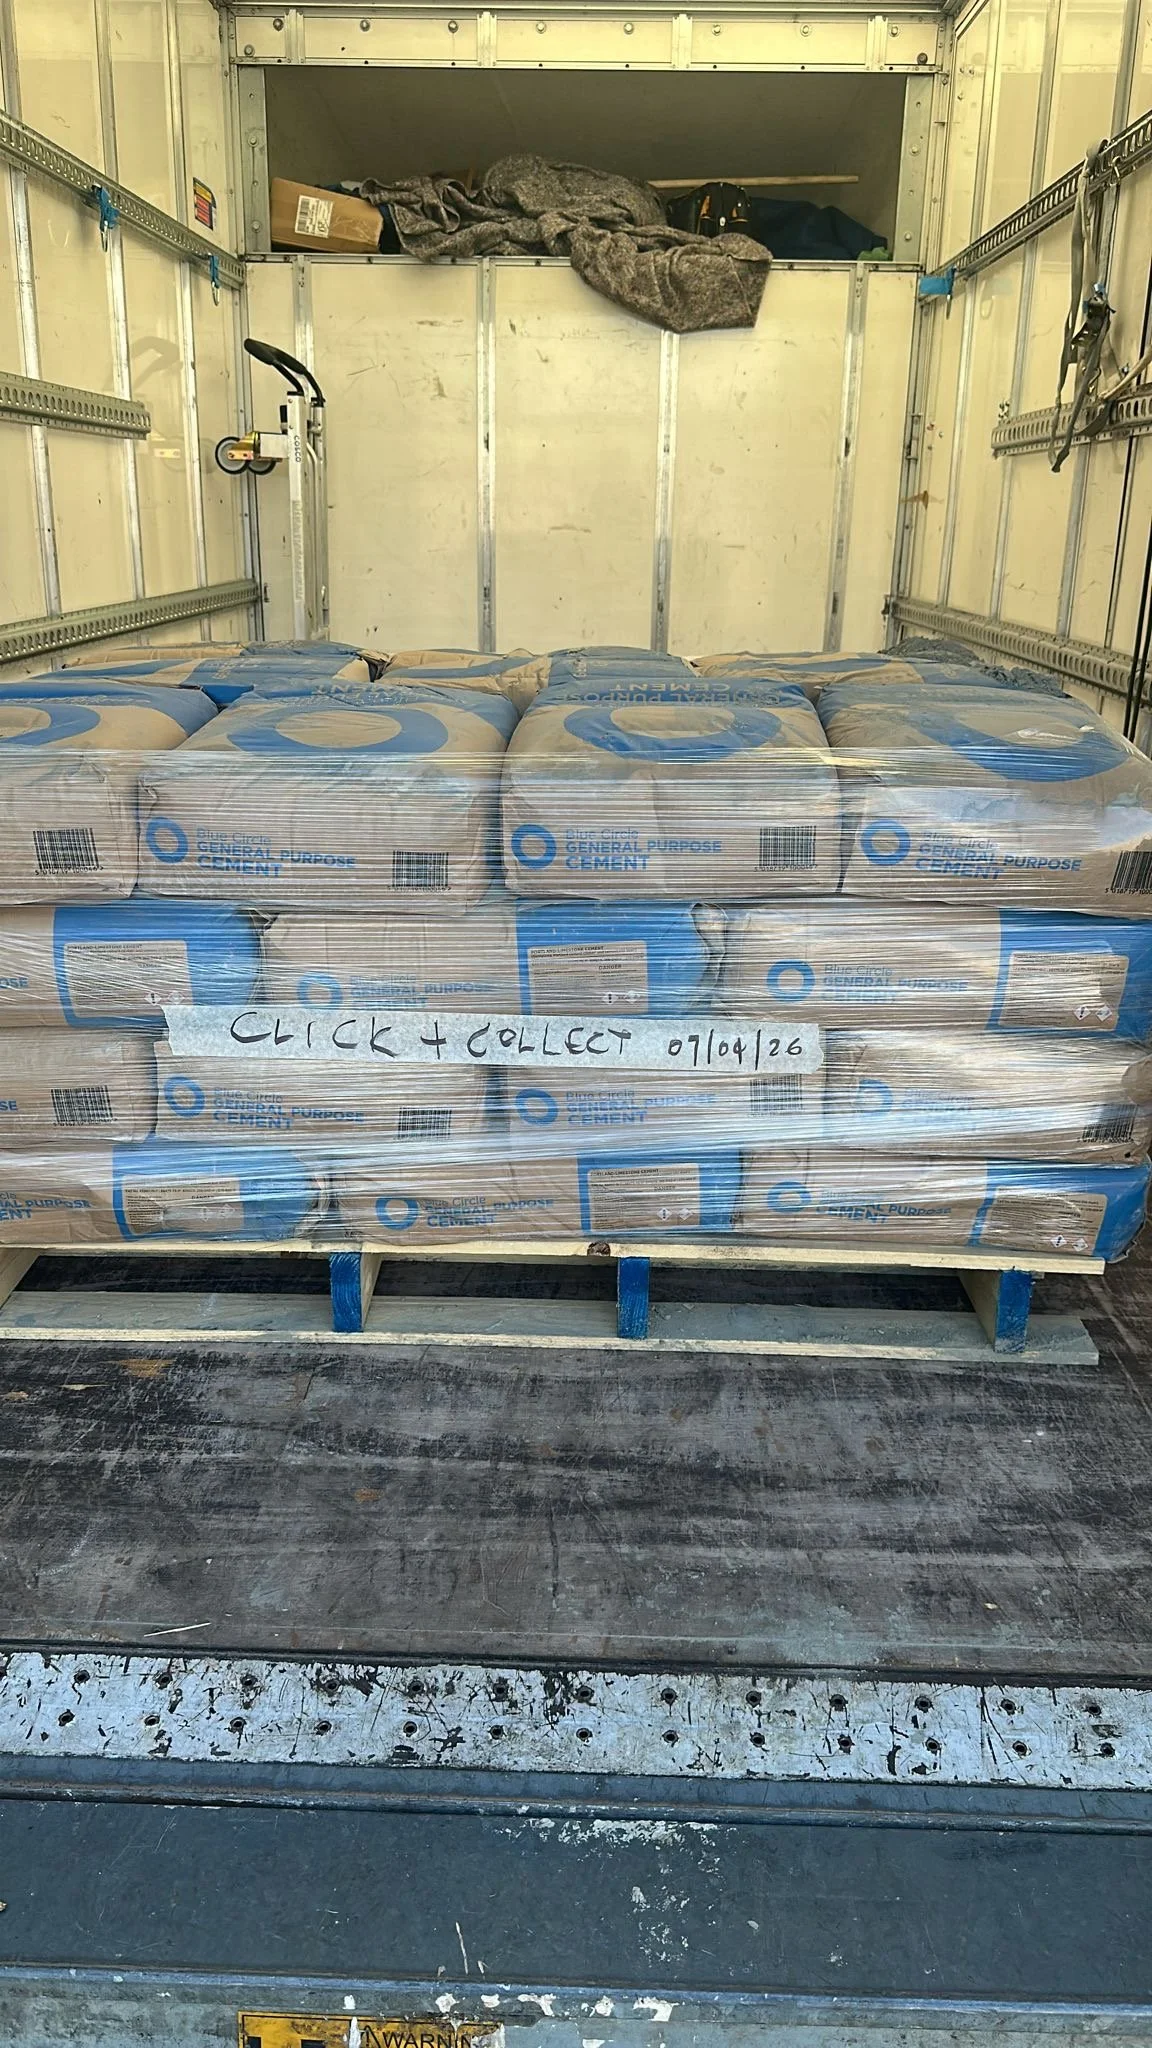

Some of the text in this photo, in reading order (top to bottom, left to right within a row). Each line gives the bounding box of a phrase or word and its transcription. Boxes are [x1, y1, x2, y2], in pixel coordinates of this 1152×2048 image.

[609, 682, 731, 692] CEMENT
[232, 831, 272, 846] Circle
[566, 828, 639, 840] Blue Circle
[566, 840, 723, 854] GENERAL PURPOSE
[197, 841, 357, 868] GENERAL PURPOSE
[919, 843, 1083, 871] GENERAL PURPOSE
[197, 855, 283, 877] CEMENT
[566, 855, 650, 870] CEMENT
[916, 858, 1004, 880] CEMENT
[824, 964, 893, 977] Blue Circle
[824, 976, 892, 987] GENERAL
[230, 1011, 803, 1071] CLICK + COLLECT 07/04/26
[214, 1098, 365, 1122] GENERAL PURPOSE
[213, 1110, 294, 1129] CEMENT
[568, 1111, 648, 1125] CEMENT
[452, 1195, 486, 1208] Circle
[0, 1208, 32, 1220] ENT
[888, 1204, 952, 1216] PURPOSE
[427, 1213, 498, 1227] CEMENT
[382, 2031, 473, 2048] WARNIN
